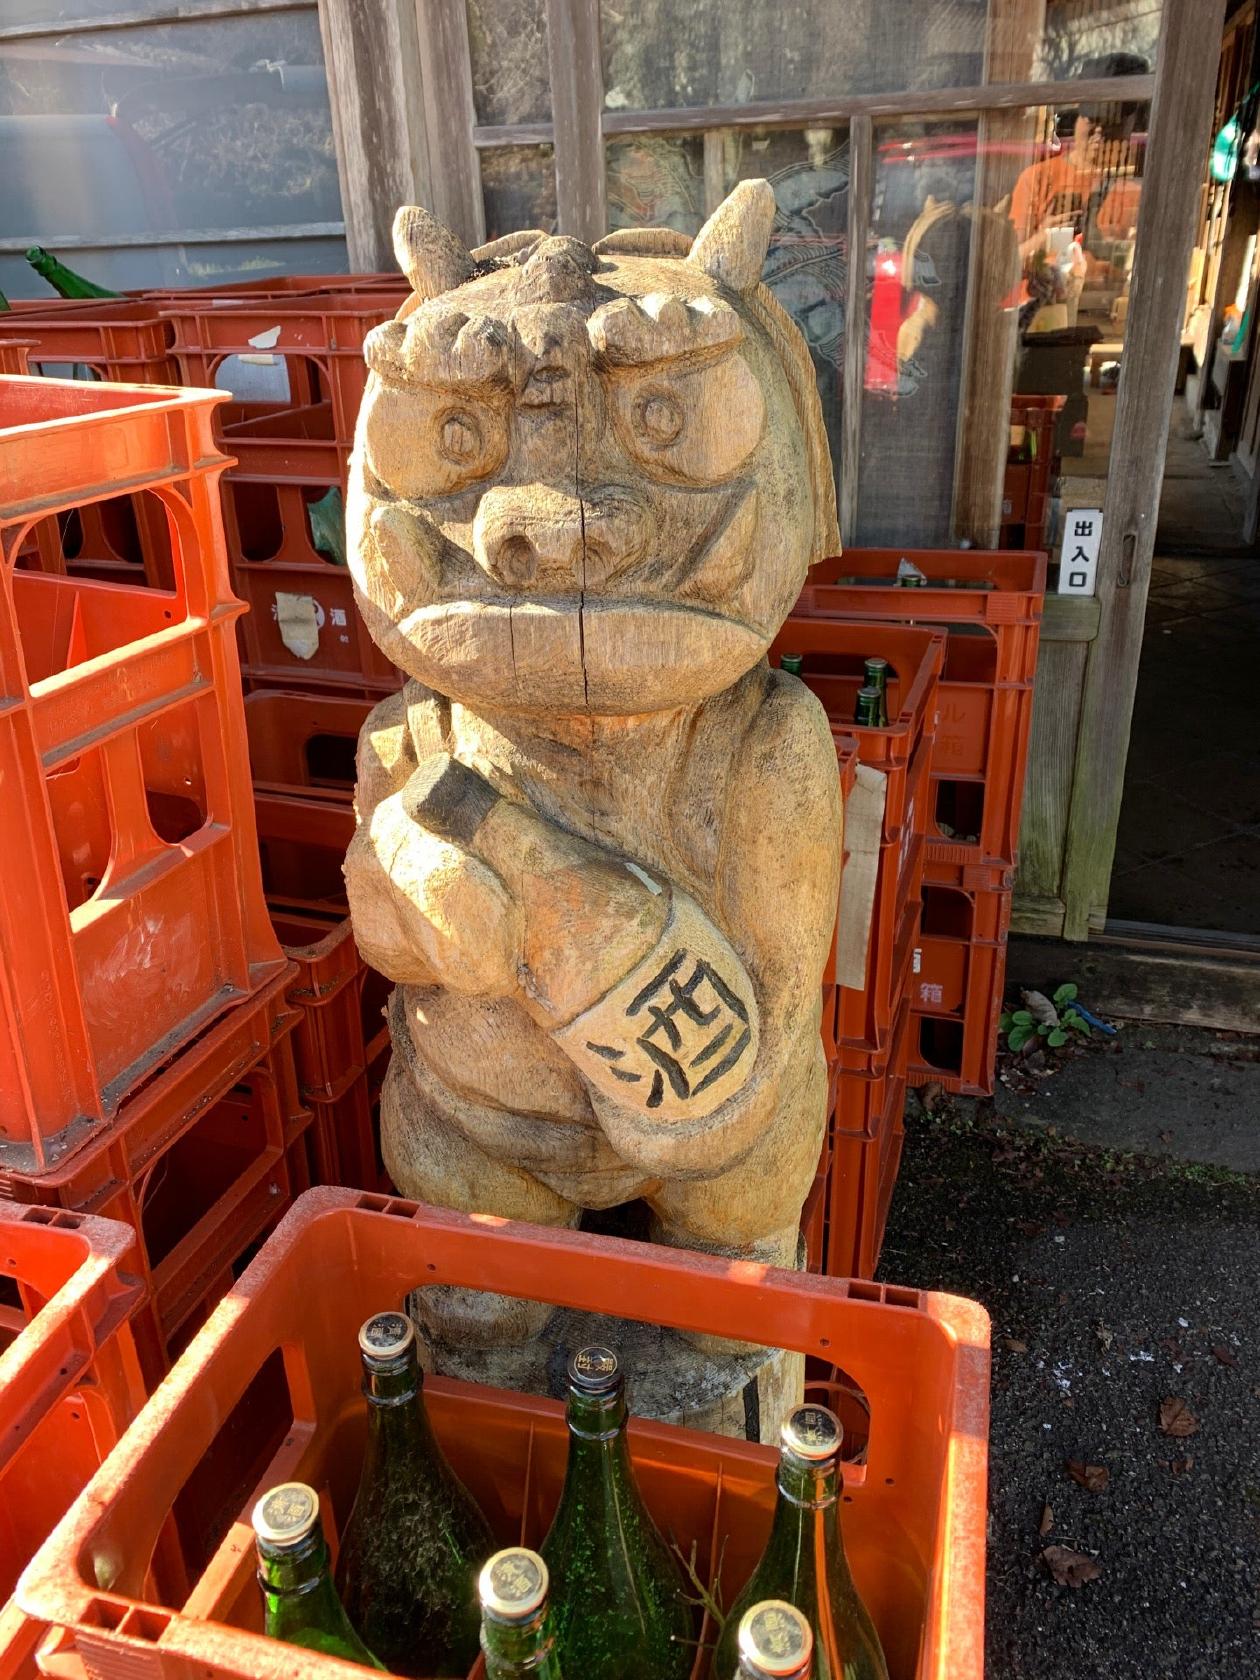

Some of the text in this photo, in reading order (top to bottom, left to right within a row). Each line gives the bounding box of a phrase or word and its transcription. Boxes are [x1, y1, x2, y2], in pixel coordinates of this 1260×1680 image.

[1068, 520, 1093, 588] 出入口
[585, 947, 752, 1109] 酒
